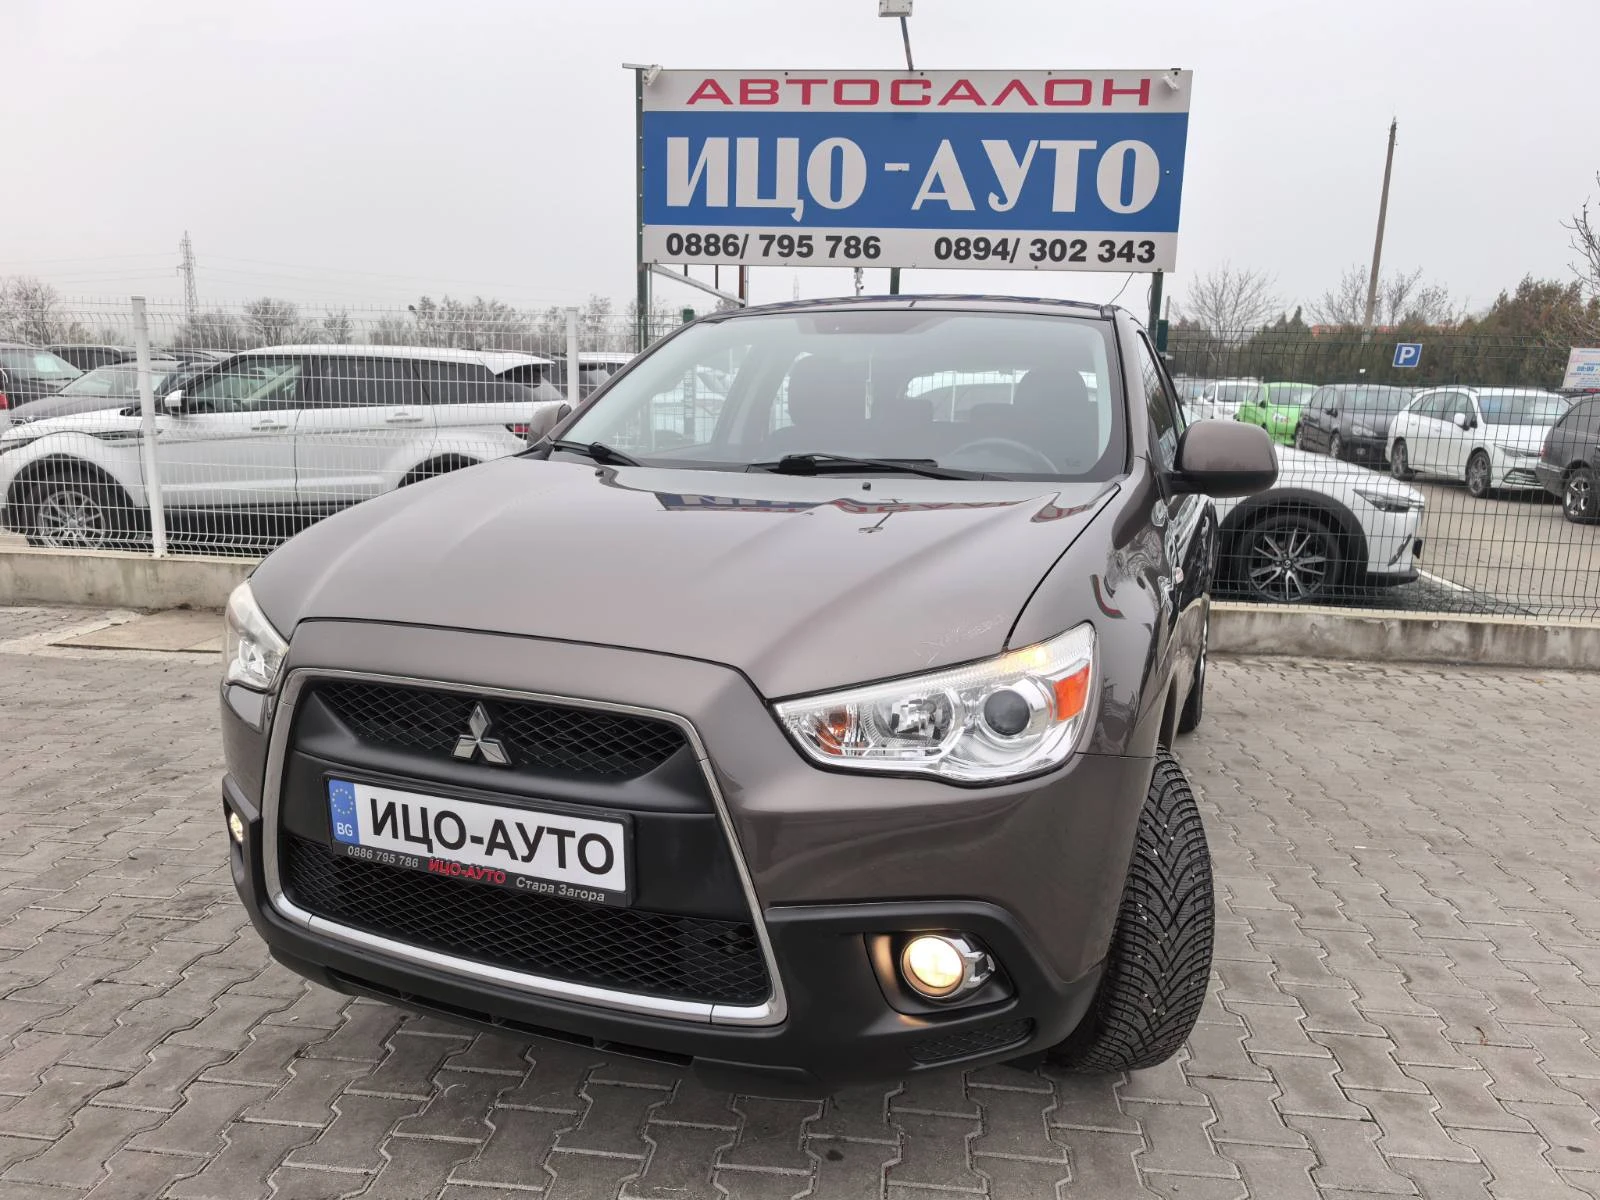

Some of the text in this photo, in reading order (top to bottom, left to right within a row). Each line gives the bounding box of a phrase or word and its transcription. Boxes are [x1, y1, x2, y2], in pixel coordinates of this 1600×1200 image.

[687, 79, 1151, 107] АВТОСАЛОН
[666, 232, 881, 260] 0886/ 795 786
[934, 236, 1156, 264] 0894/ 302 343
[1398, 346, 1416, 364] P
[336, 822, 353, 837] BG
[370, 798, 614, 875] ИЦО-АУТО
[347, 845, 605, 902] 0886 795 786 ИЦО-АУТО Стара Загора
